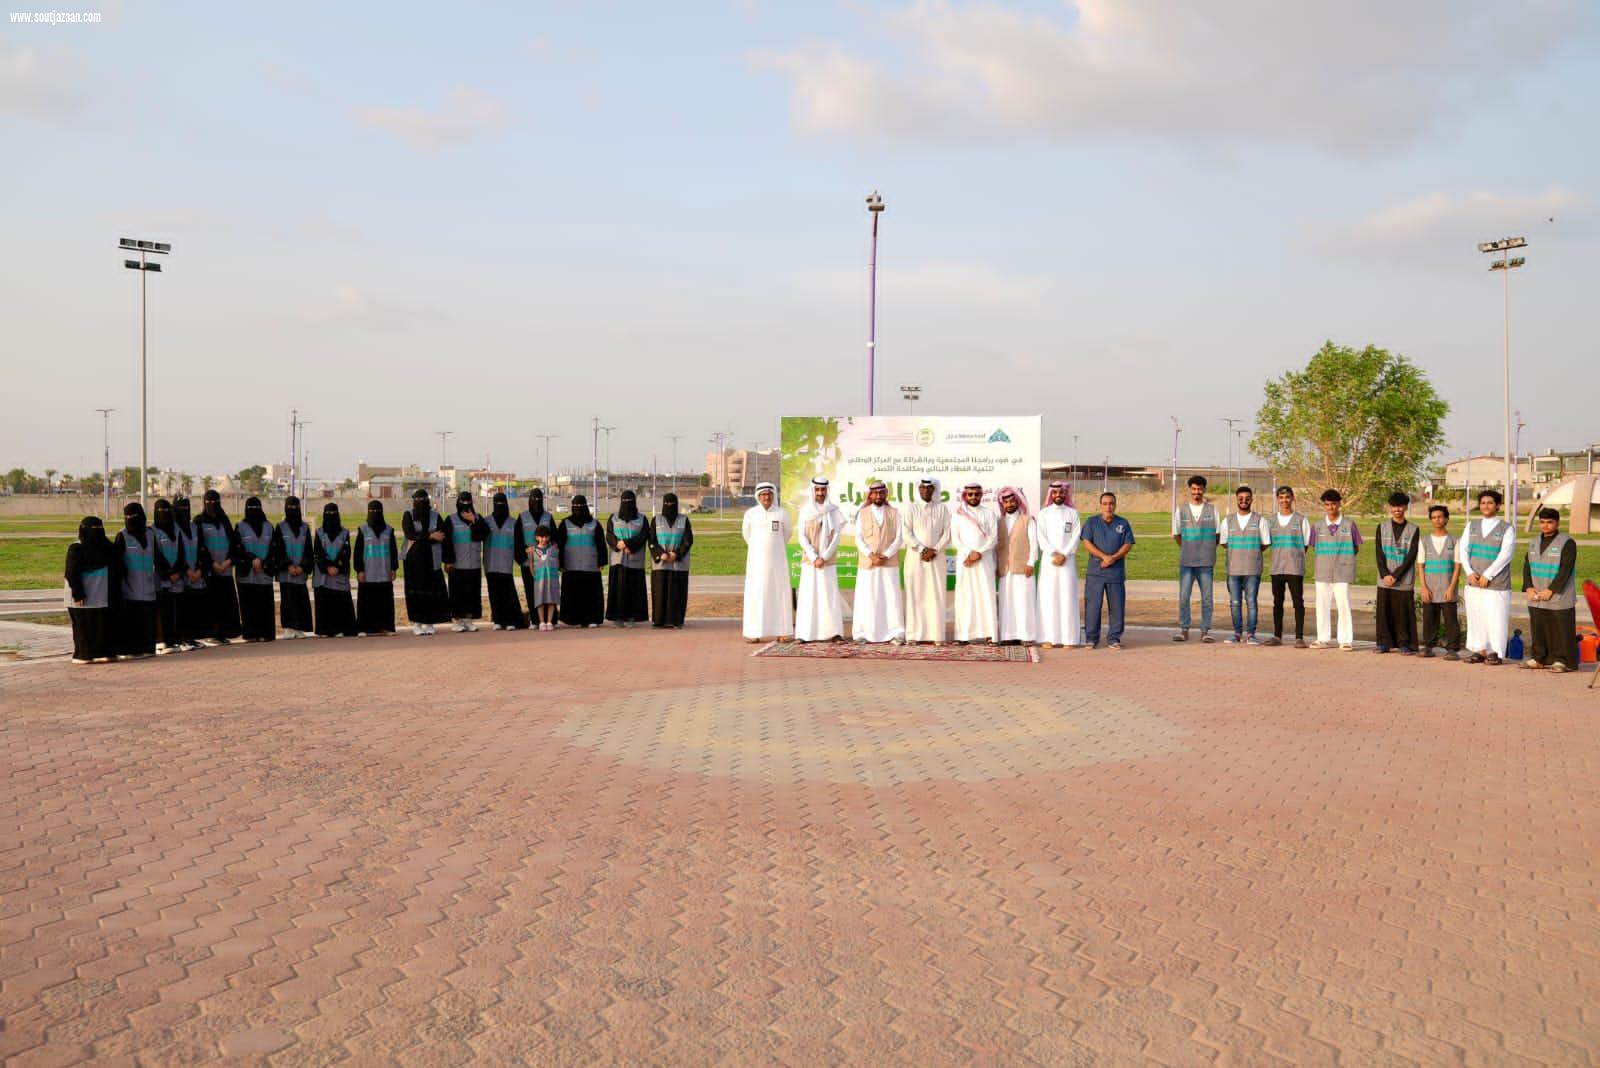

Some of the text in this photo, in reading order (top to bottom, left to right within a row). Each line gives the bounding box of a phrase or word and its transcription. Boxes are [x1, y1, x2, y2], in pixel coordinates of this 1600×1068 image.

[847, 455, 872, 464] الوطني
[873, 455, 892, 464] المركز
[892, 456, 902, 465] مع
[903, 455, 935, 465] وبالشراكة
[936, 455, 970, 464] المجتمعية
[995, 456, 1009, 464] ضوء
[873, 464, 995, 474] لتنمية الغطاء النباتي ومكافحة التصحر
